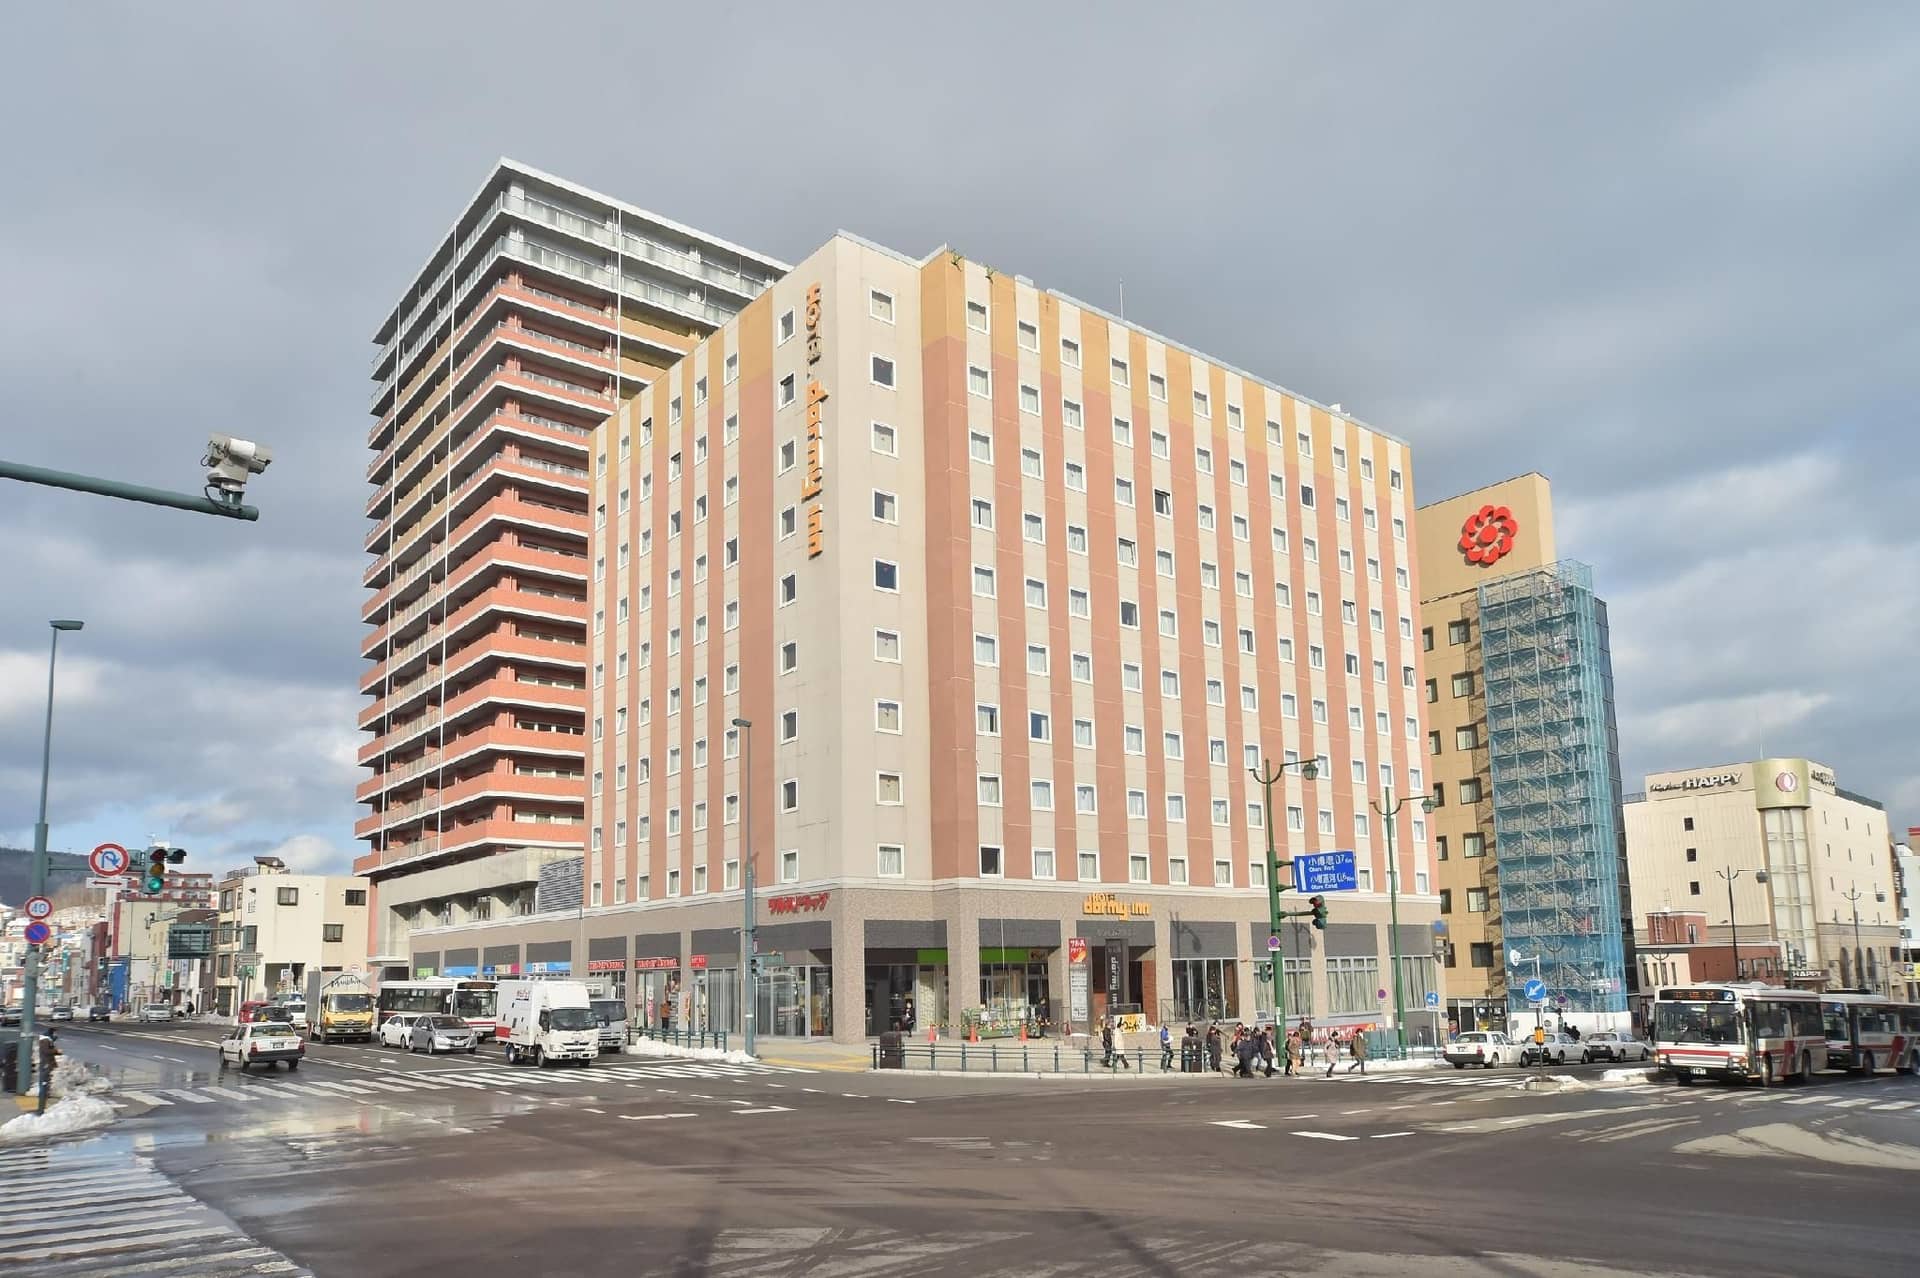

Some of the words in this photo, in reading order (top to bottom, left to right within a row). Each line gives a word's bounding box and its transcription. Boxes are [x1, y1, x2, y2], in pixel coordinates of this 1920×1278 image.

[801, 380, 829, 501] dormy
[807, 503, 823, 558] inn
[1686, 772, 1742, 790] HAPPY
[31, 903, 48, 913] 40
[1083, 894, 1129, 921] dormy
[1132, 902, 1149, 915] inn
